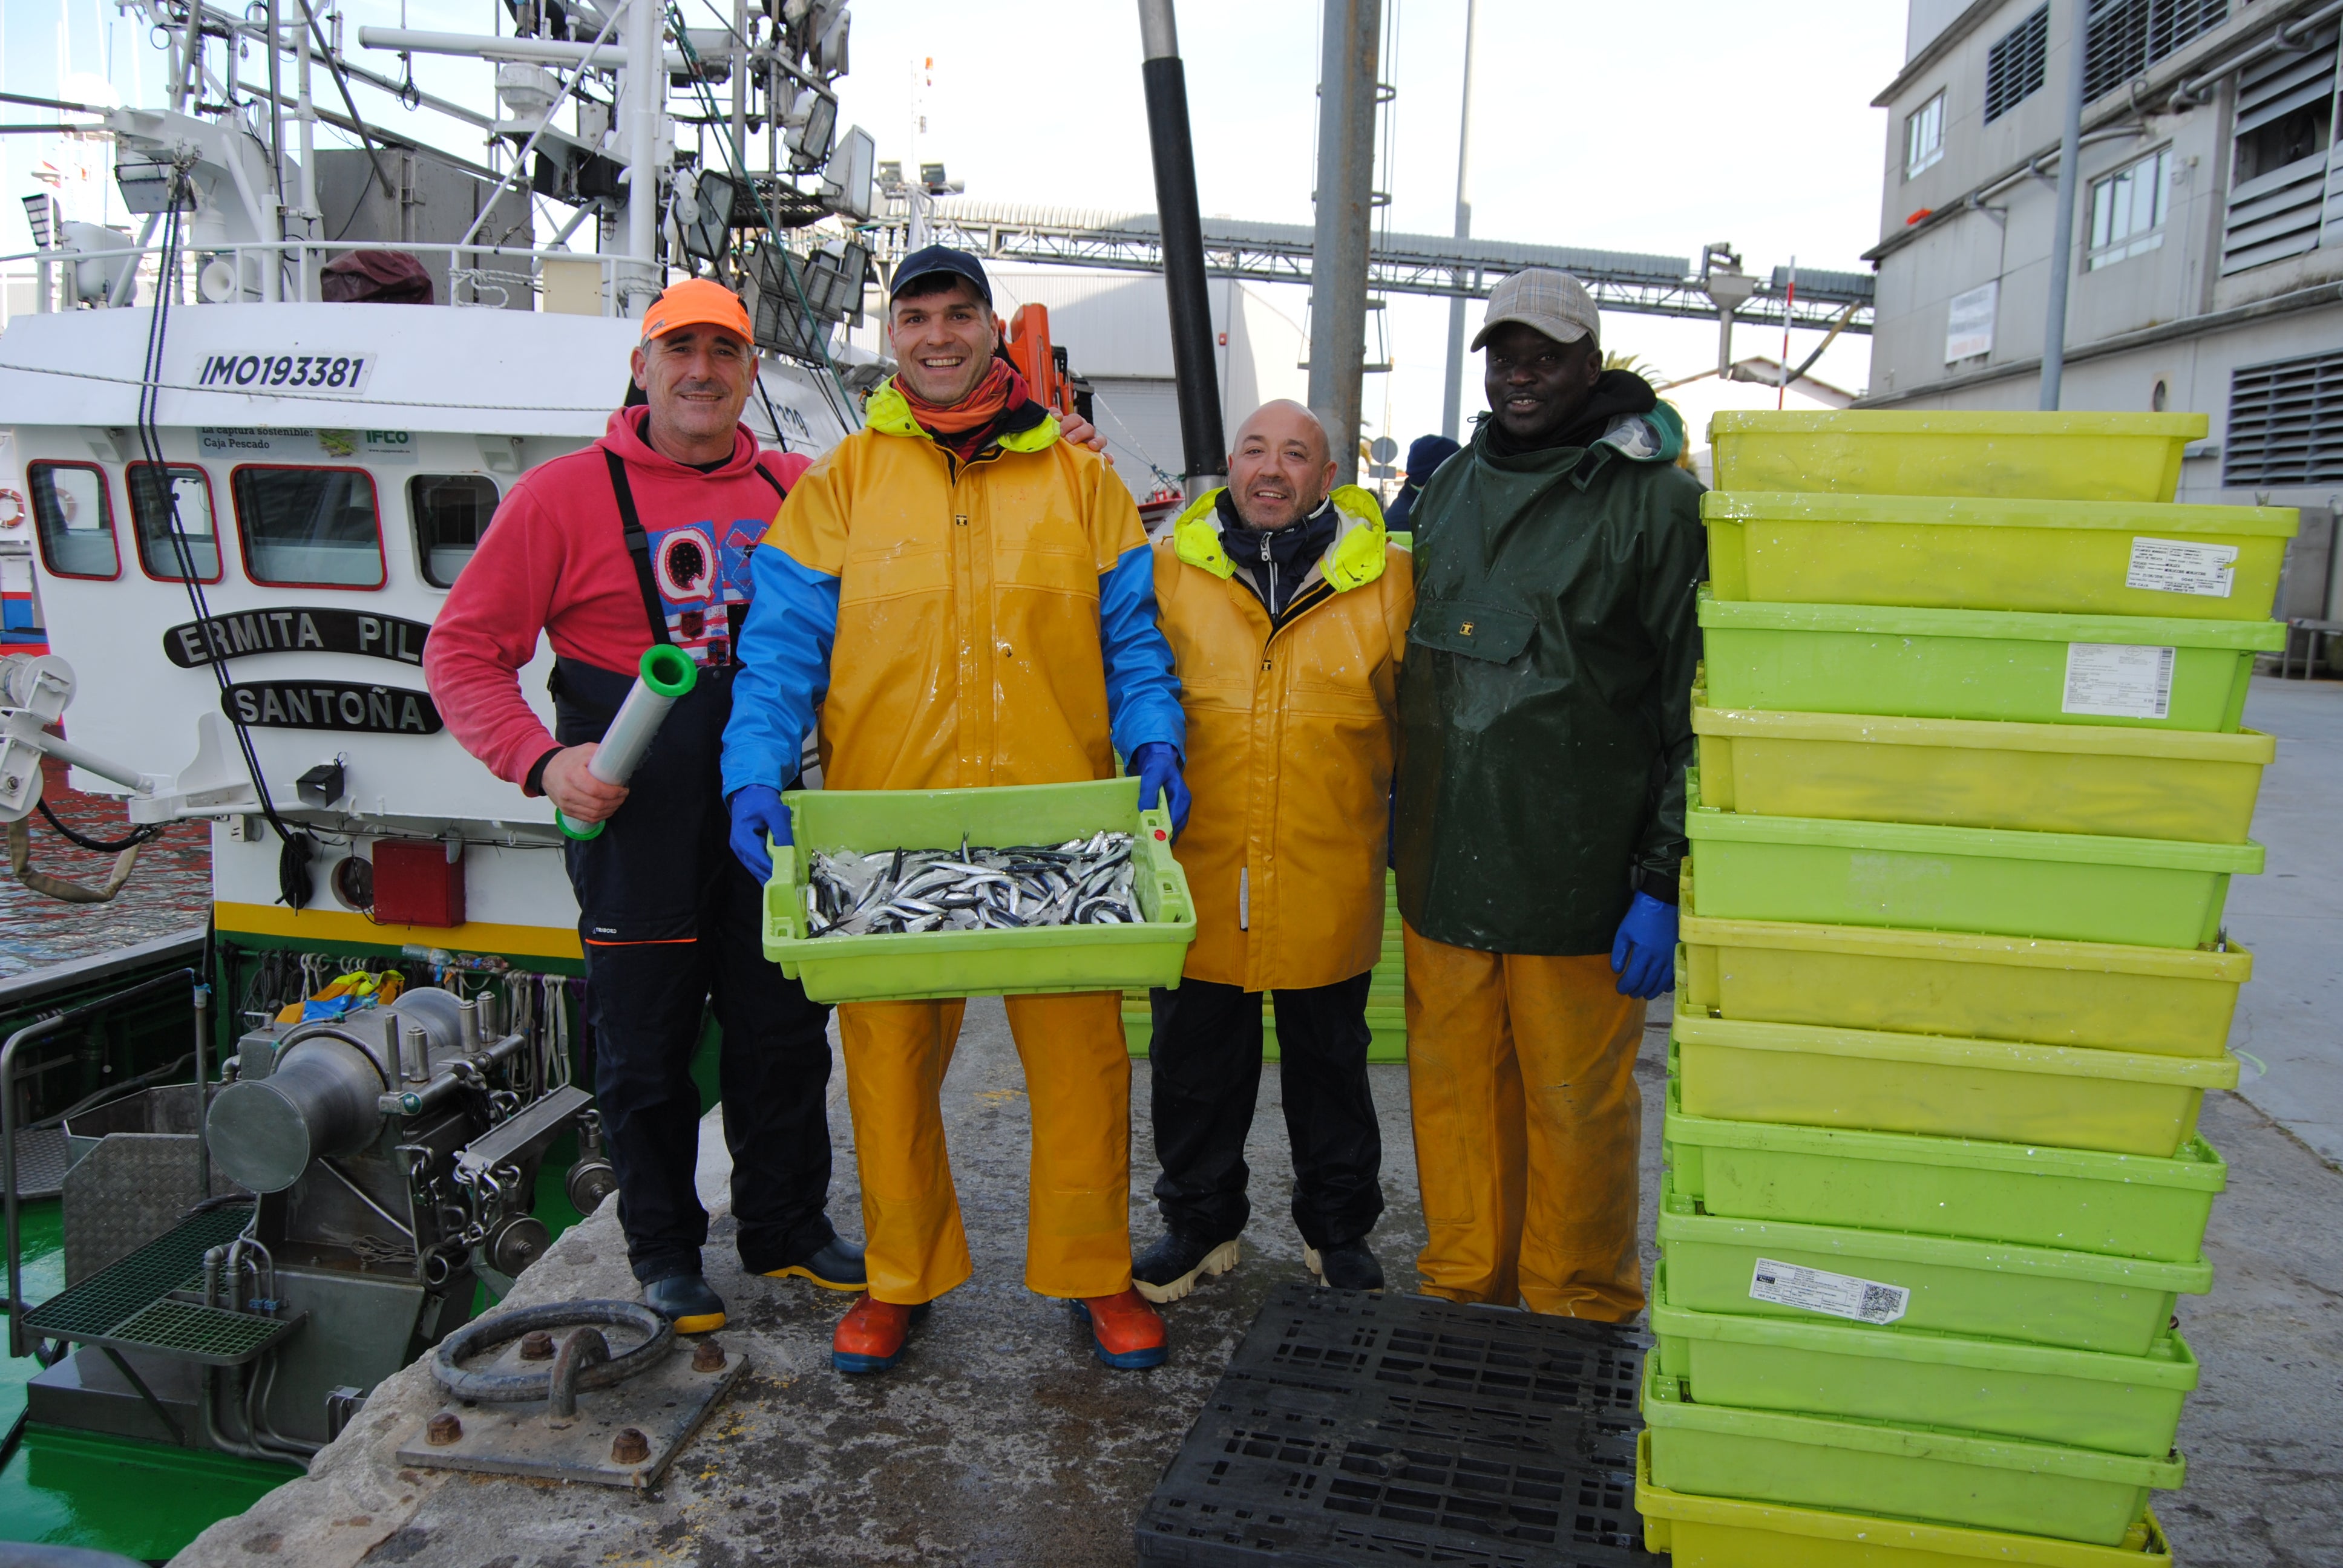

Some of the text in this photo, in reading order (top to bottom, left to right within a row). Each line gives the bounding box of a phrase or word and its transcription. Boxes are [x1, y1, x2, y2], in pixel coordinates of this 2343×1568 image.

[199, 355, 364, 387] IMO193381
[217, 426, 255, 436] captura
[257, 428, 313, 437] sostenible:
[366, 430, 409, 444] IFCO
[204, 438, 270, 449] Caja Pescado
[177, 612, 324, 664] ERMITA
[234, 687, 426, 731] SANTOÑA
